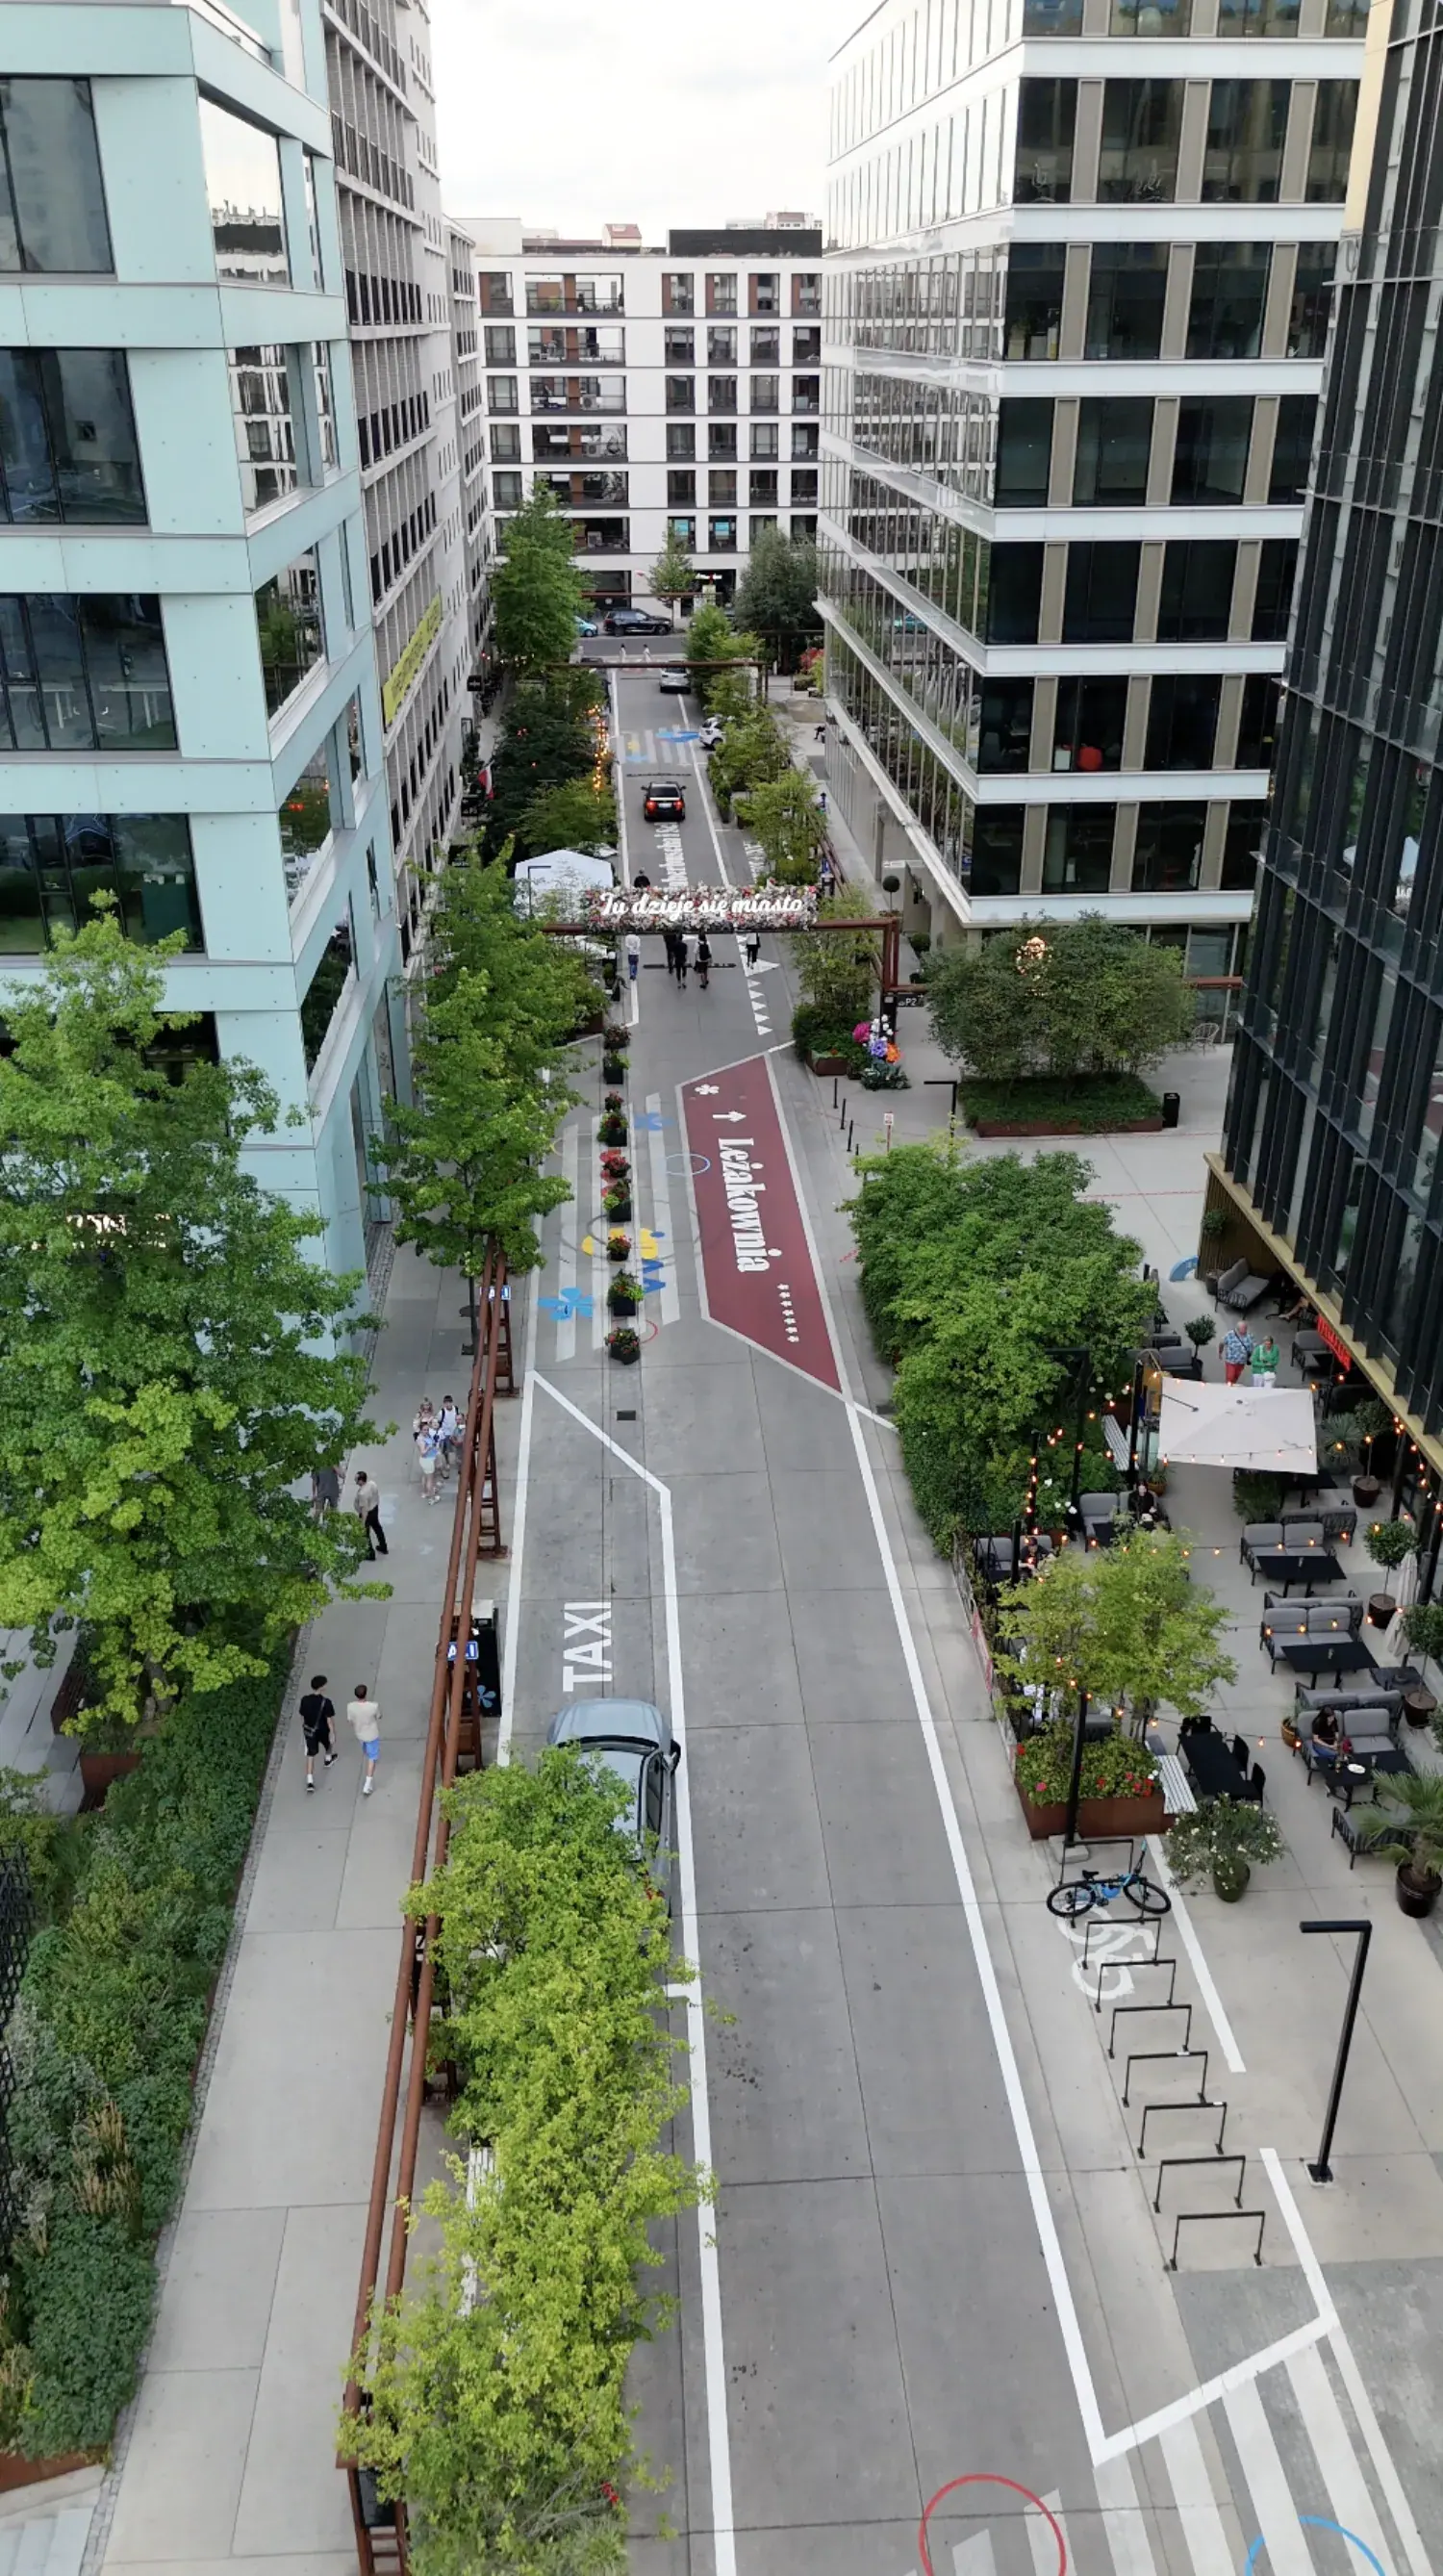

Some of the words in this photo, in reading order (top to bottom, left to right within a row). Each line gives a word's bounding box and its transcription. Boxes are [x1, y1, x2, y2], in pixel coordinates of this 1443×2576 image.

[599, 892, 628, 916] Tu
[632, 893, 695, 921] dzieje
[698, 894, 728, 917] się
[732, 894, 802, 913] miasto
[718, 1137, 783, 1273] Leżakownia
[563, 1601, 613, 1692] TAXI
